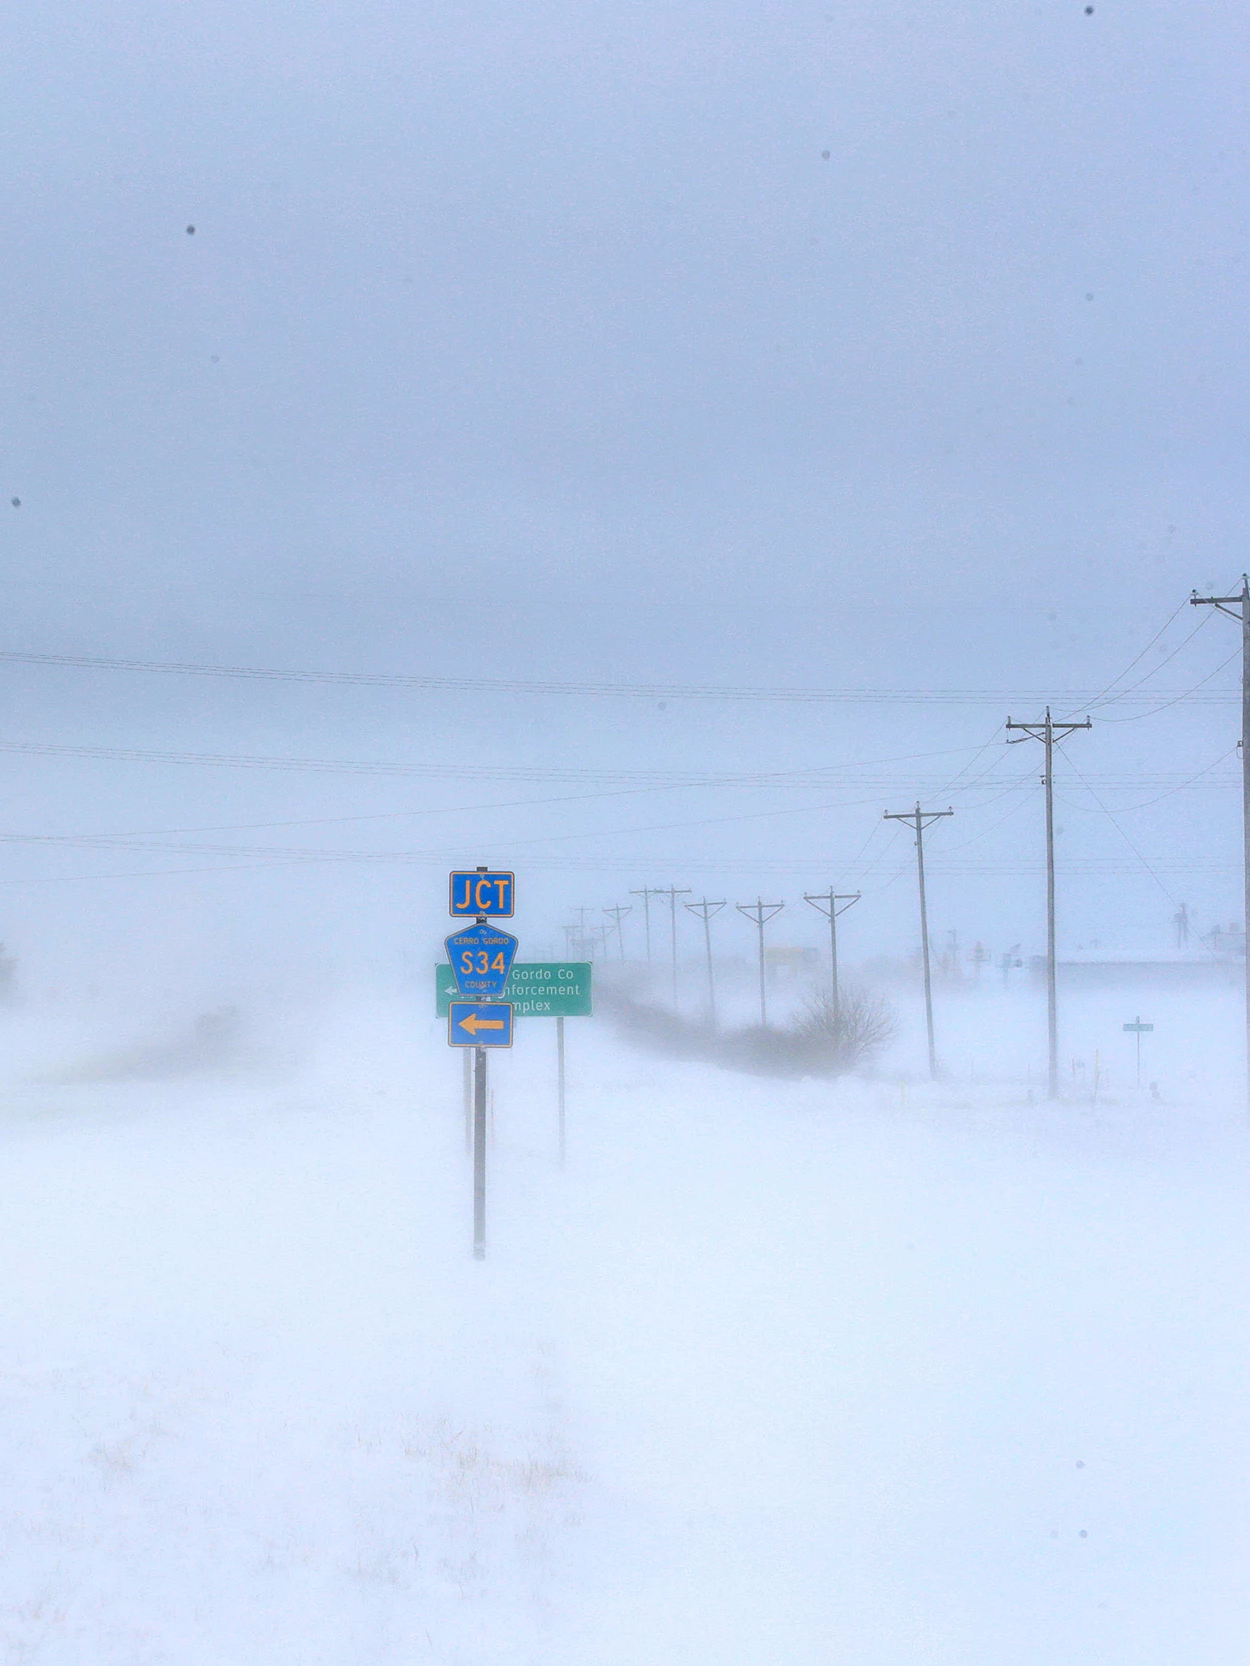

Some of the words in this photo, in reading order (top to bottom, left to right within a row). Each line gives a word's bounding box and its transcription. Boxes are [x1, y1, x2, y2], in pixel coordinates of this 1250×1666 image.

[455, 879, 510, 909] JCT
[453, 937, 479, 945] CERRO
[483, 937, 510, 945] GORDO
[460, 951, 505, 975] S34
[512, 968, 552, 980] Gordo
[557, 968, 574, 980] Co
[464, 980, 498, 989] COUNTY
[504, 984, 580, 996] nforcement
[512, 999, 551, 1014] mplex
